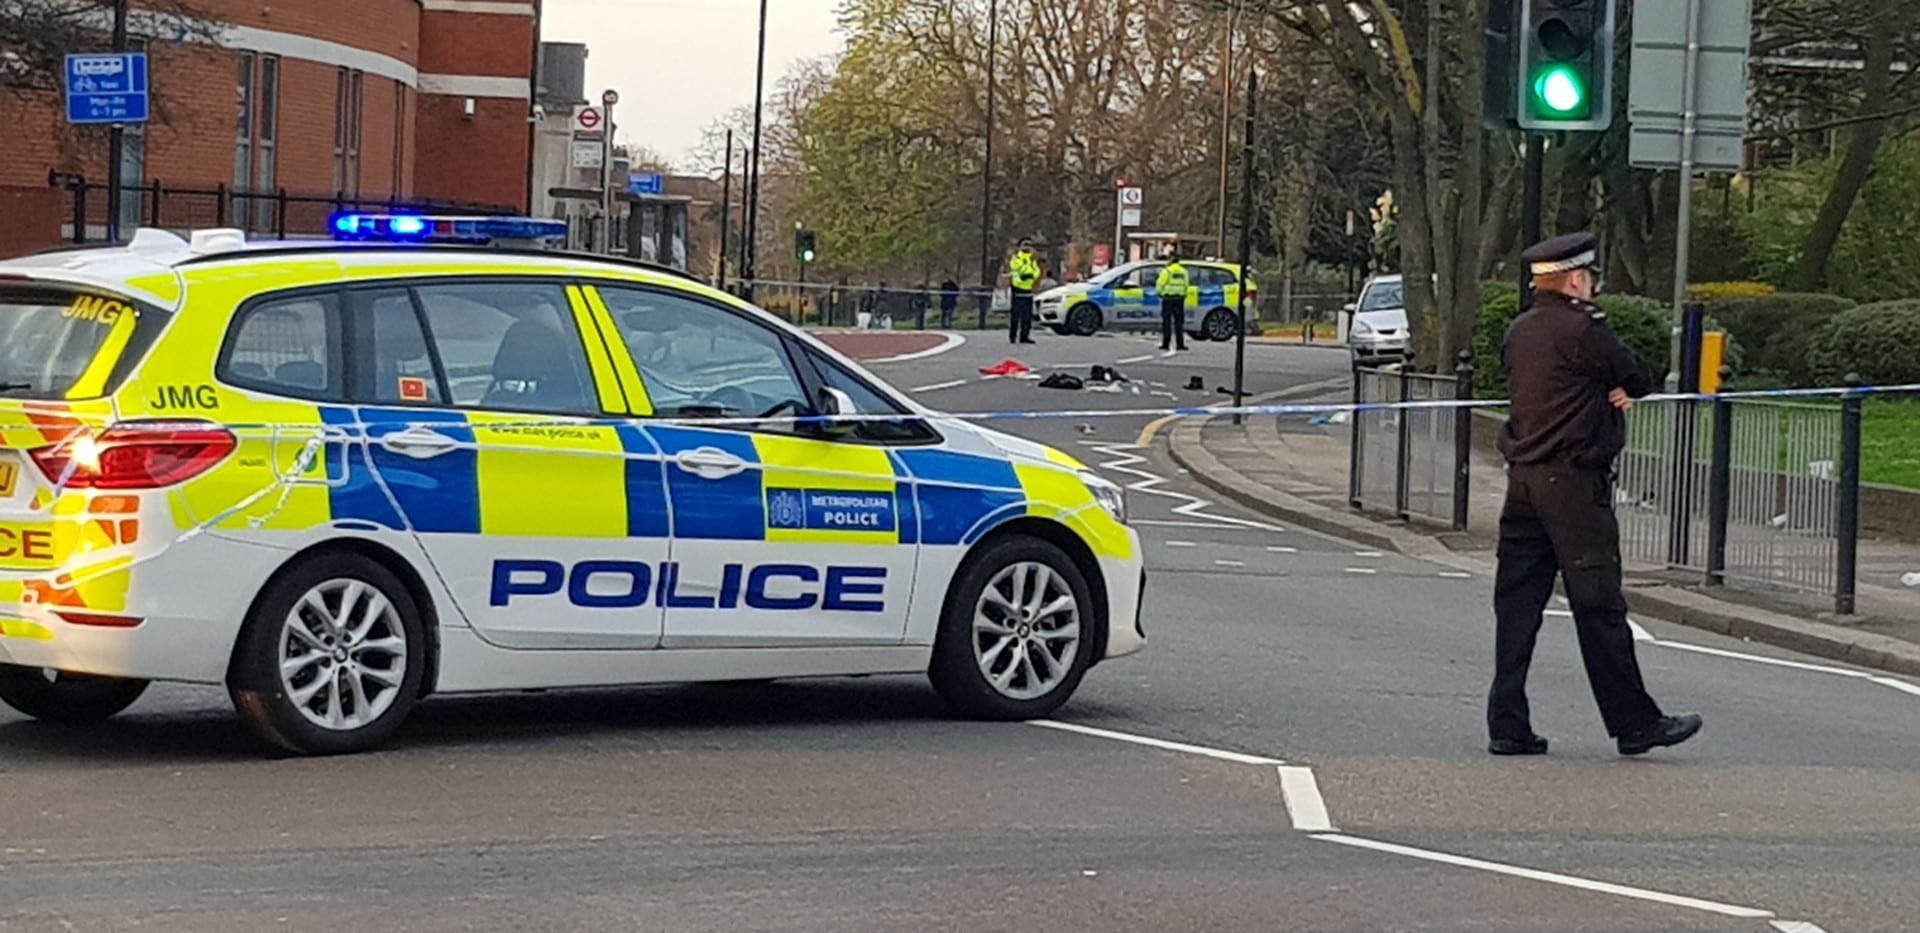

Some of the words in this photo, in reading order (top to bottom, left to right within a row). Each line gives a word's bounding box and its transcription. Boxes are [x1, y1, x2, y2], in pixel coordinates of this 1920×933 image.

[62, 296, 122, 325] JMG
[151, 385, 219, 410] JMG
[824, 511, 879, 525] POLICE
[489, 559, 888, 612] POLICE
